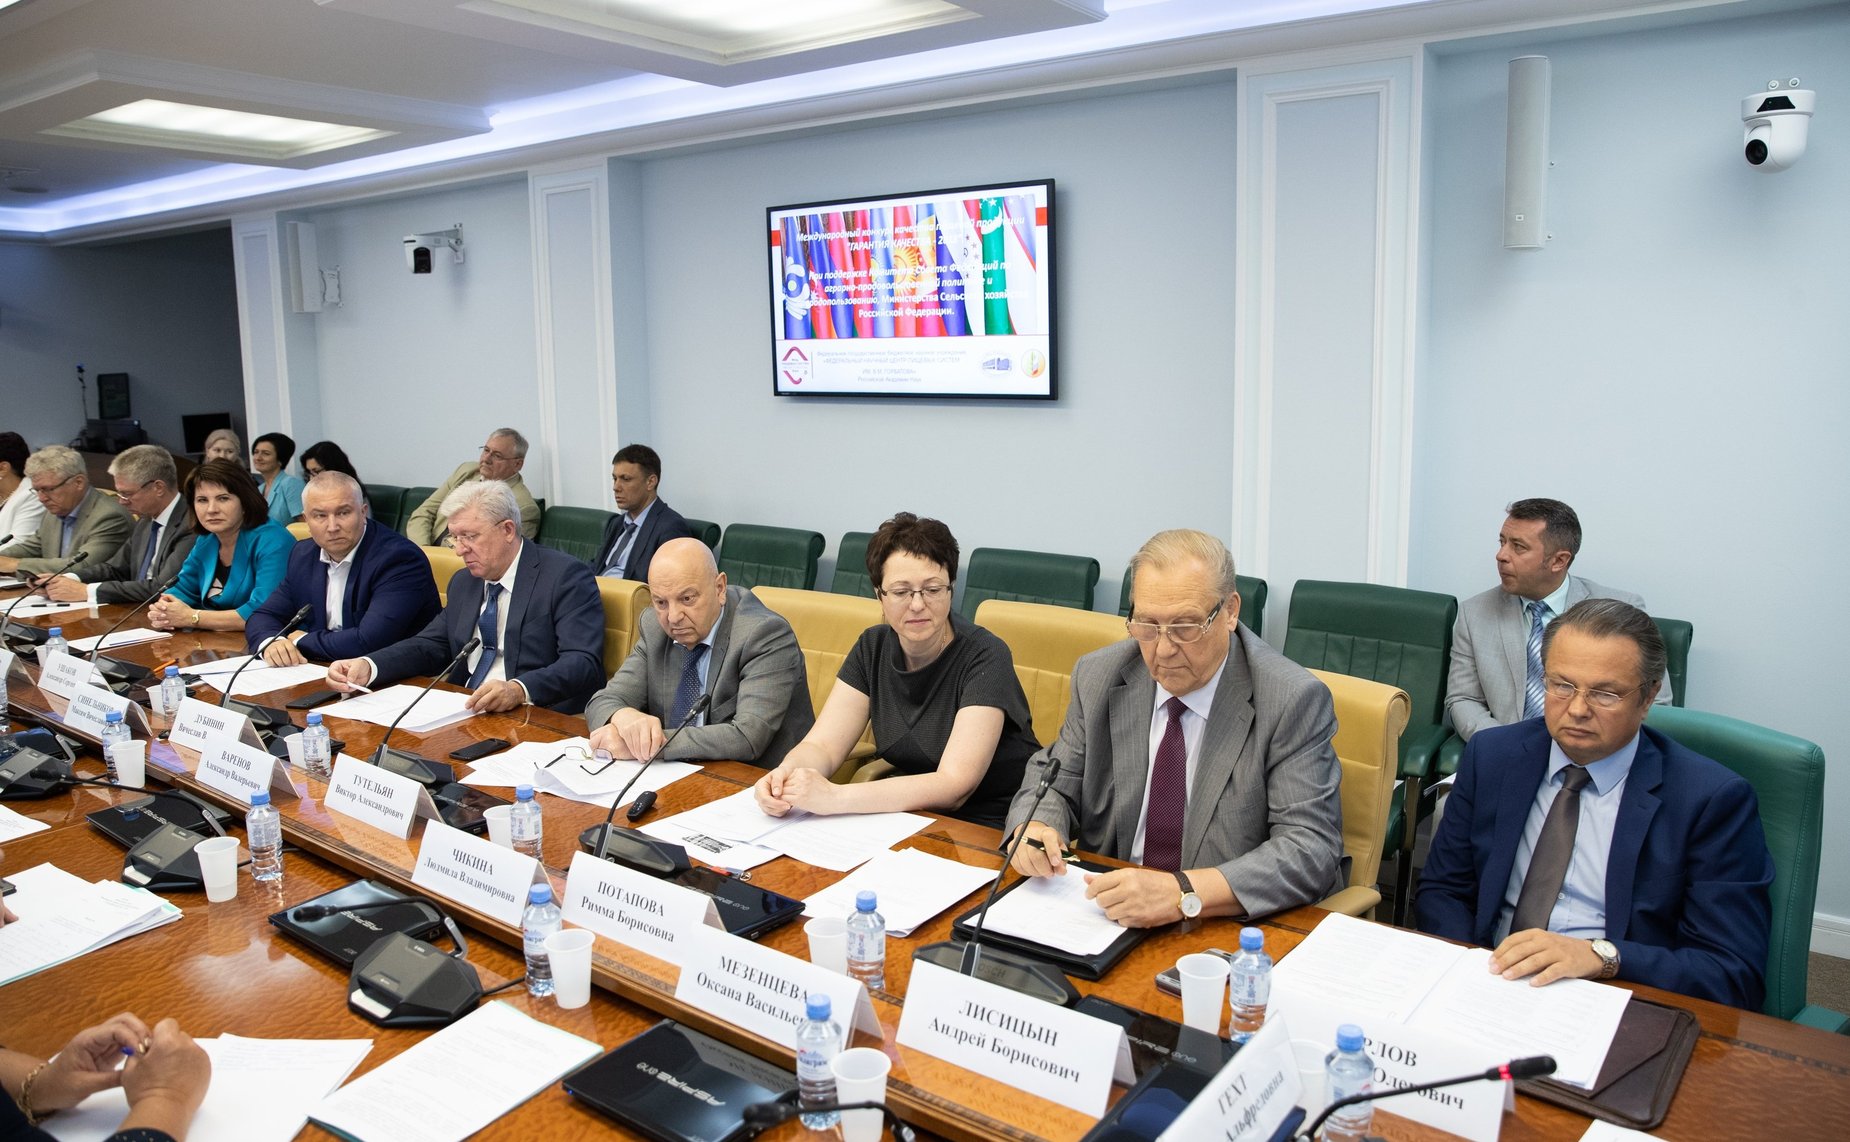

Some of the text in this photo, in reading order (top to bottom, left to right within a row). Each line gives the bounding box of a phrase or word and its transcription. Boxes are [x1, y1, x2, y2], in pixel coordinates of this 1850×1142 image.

[194, 714, 225, 731] ДУБИНИН
[205, 760, 261, 791] Александр Валерьевич
[221, 750, 252, 771] ВАРЕНОВ
[335, 783, 404, 820] Виктор Александрович
[353, 774, 394, 799] ТУТЕЛЬЯН
[452, 848, 493, 875] ЧИКИНА
[424, 857, 515, 903] Людмила Владимировна
[597, 881, 664, 917] ПОТАПОВА
[581, 896, 674, 943] Римма Борисовна
[719, 956, 808, 1004] МЕЗЕНЦЕВА
[697, 971, 805, 1027] Оксана Василье
[958, 1000, 1059, 1047] ЛИСИЦЫН
[928, 1017, 1080, 1083] Андрей Борисович
[1363, 1037, 1417, 1067] РЛОВ
